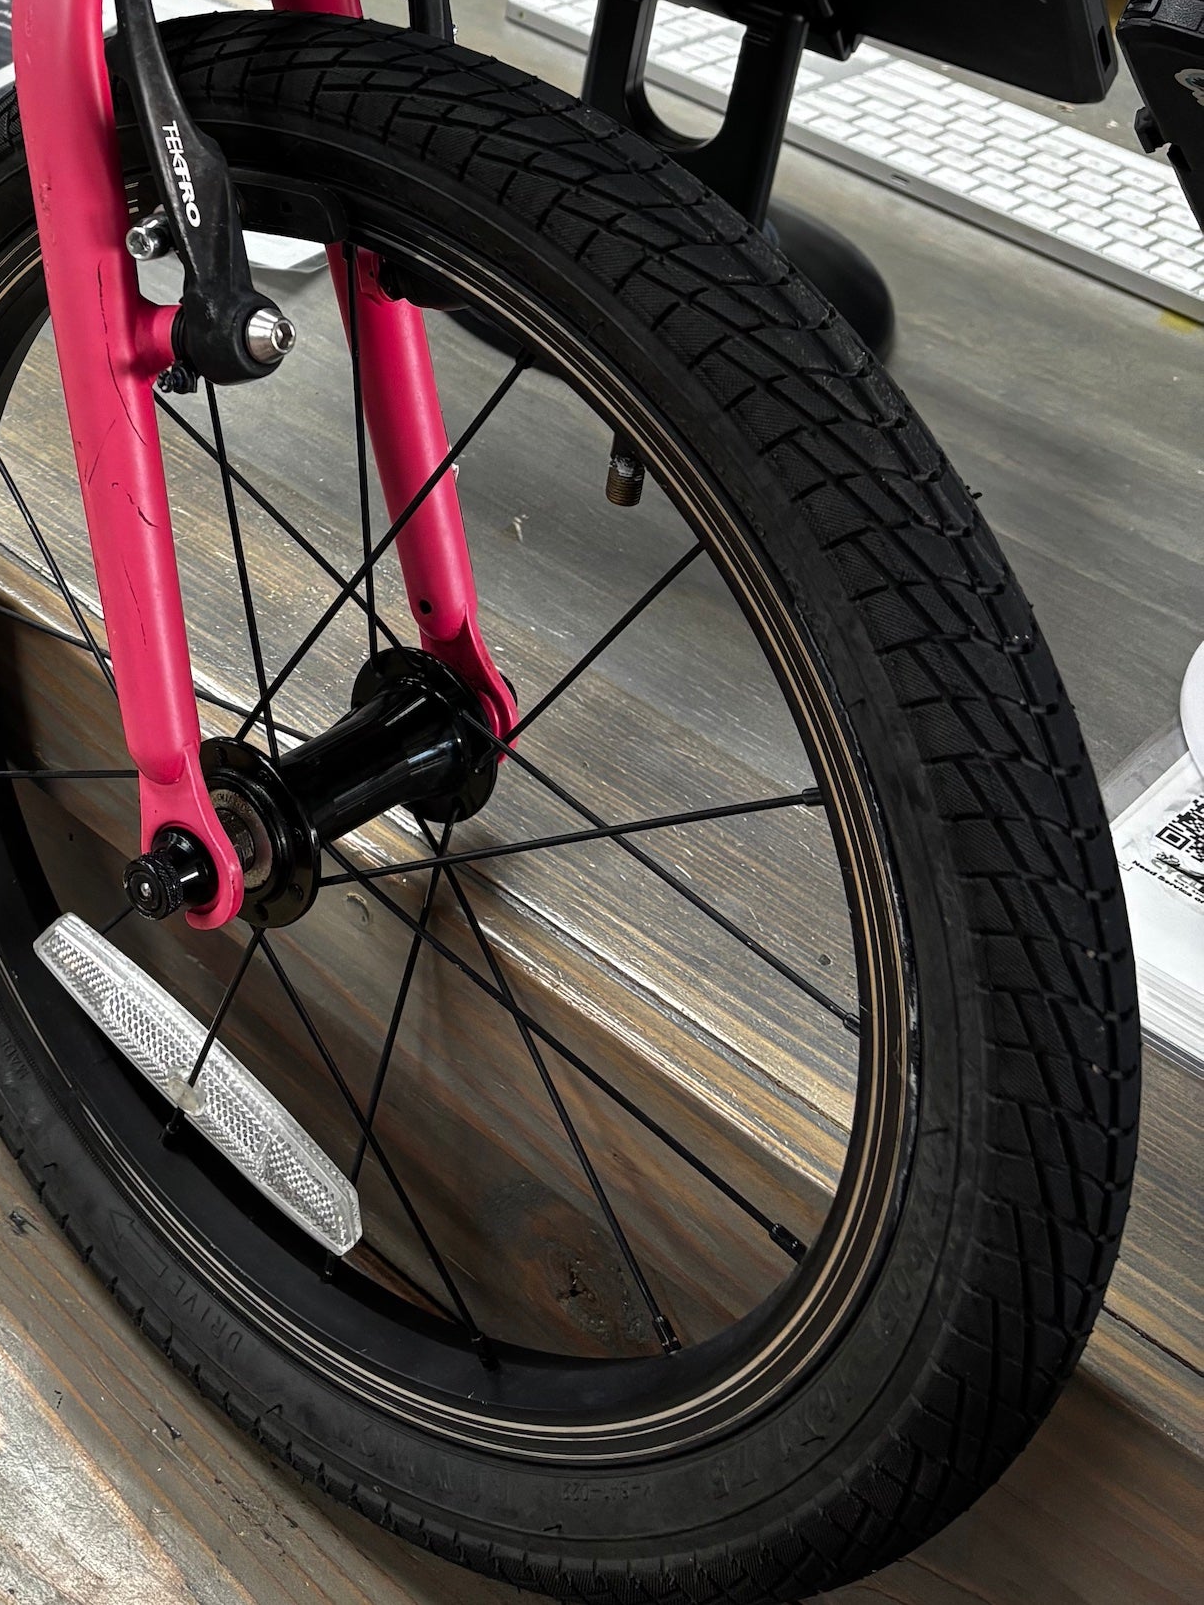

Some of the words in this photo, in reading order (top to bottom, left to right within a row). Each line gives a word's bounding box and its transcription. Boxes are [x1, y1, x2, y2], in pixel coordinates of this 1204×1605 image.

[162, 120, 200, 228] TEKTRO
[1132, 860, 1157, 876] Need
[1158, 875, 1192, 897] Service
[166, 1274, 243, 1355] DRIVE
